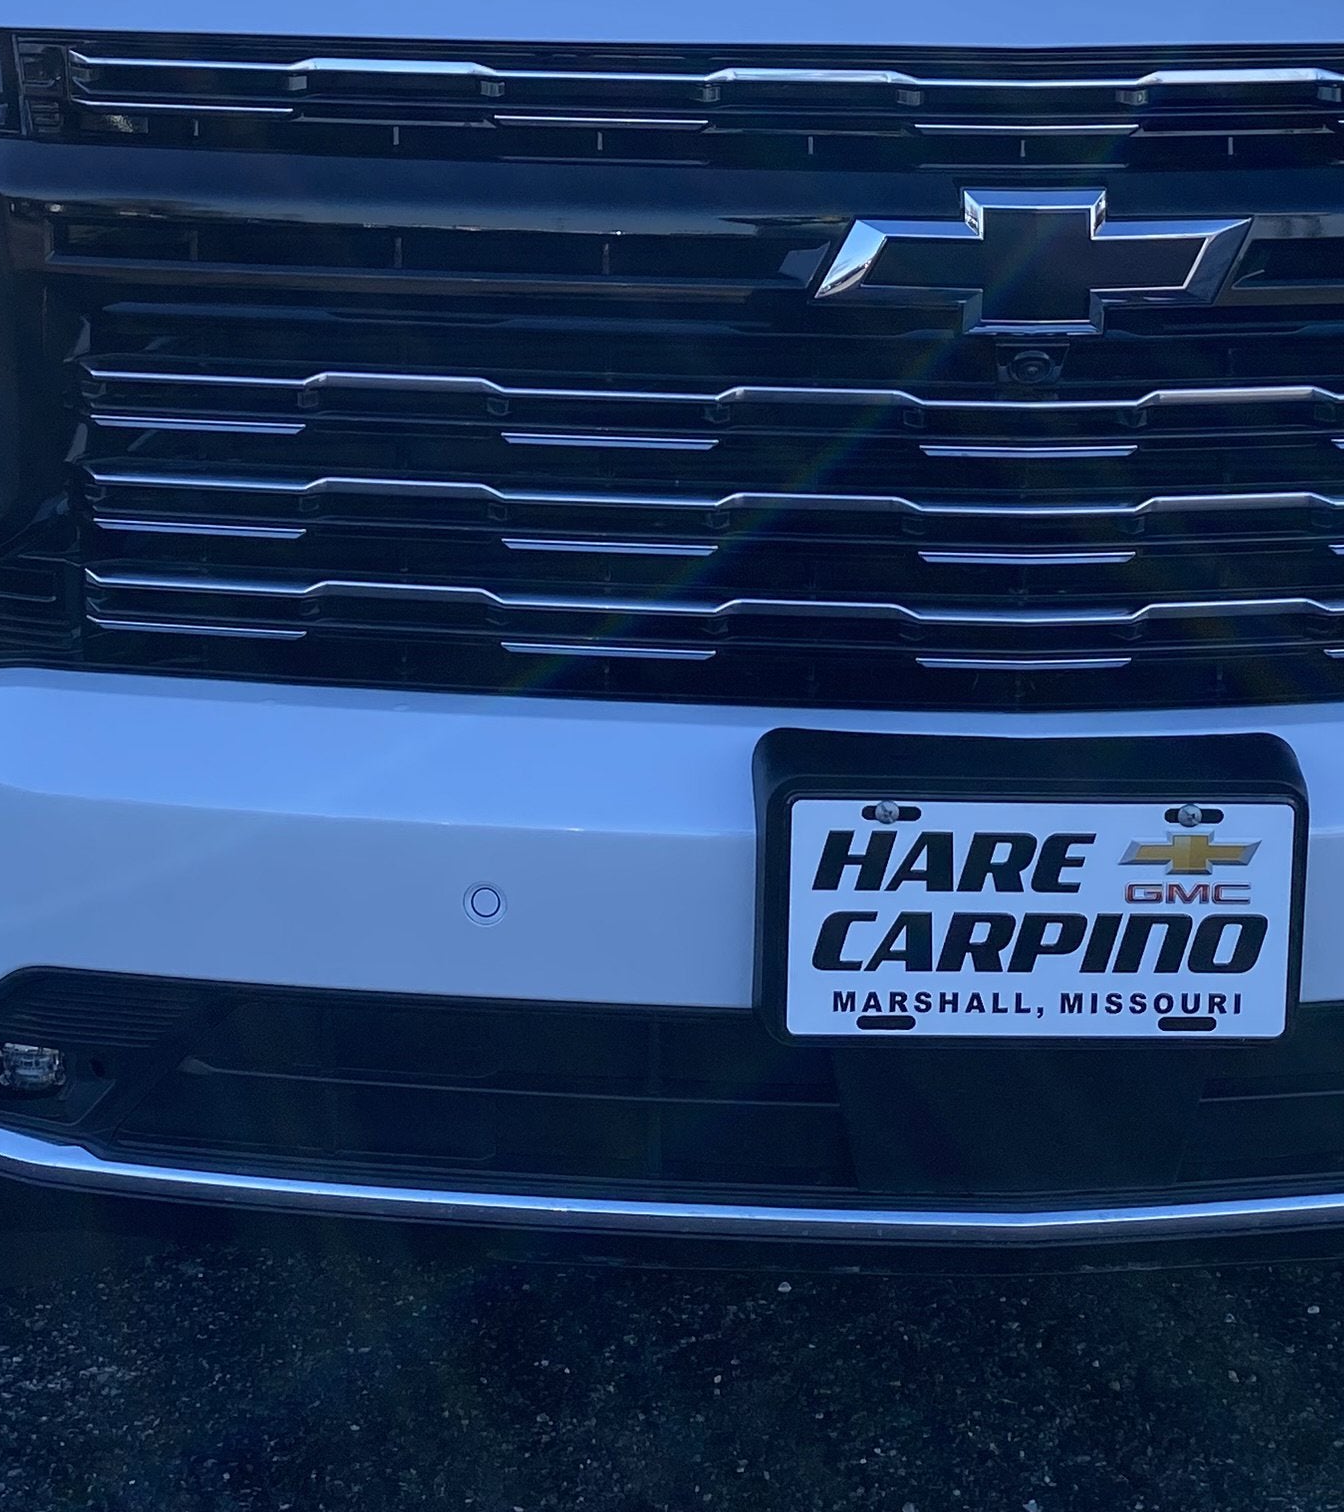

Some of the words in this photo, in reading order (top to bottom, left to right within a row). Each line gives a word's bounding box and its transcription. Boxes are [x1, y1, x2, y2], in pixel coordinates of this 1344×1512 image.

[812, 830, 1097, 893] HARE
[1124, 881, 1252, 905] GMC
[811, 911, 1269, 974] CARPINO
[832, 991, 1045, 1019] MARSHALL,
[1060, 992, 1243, 1016] MISSOURI
